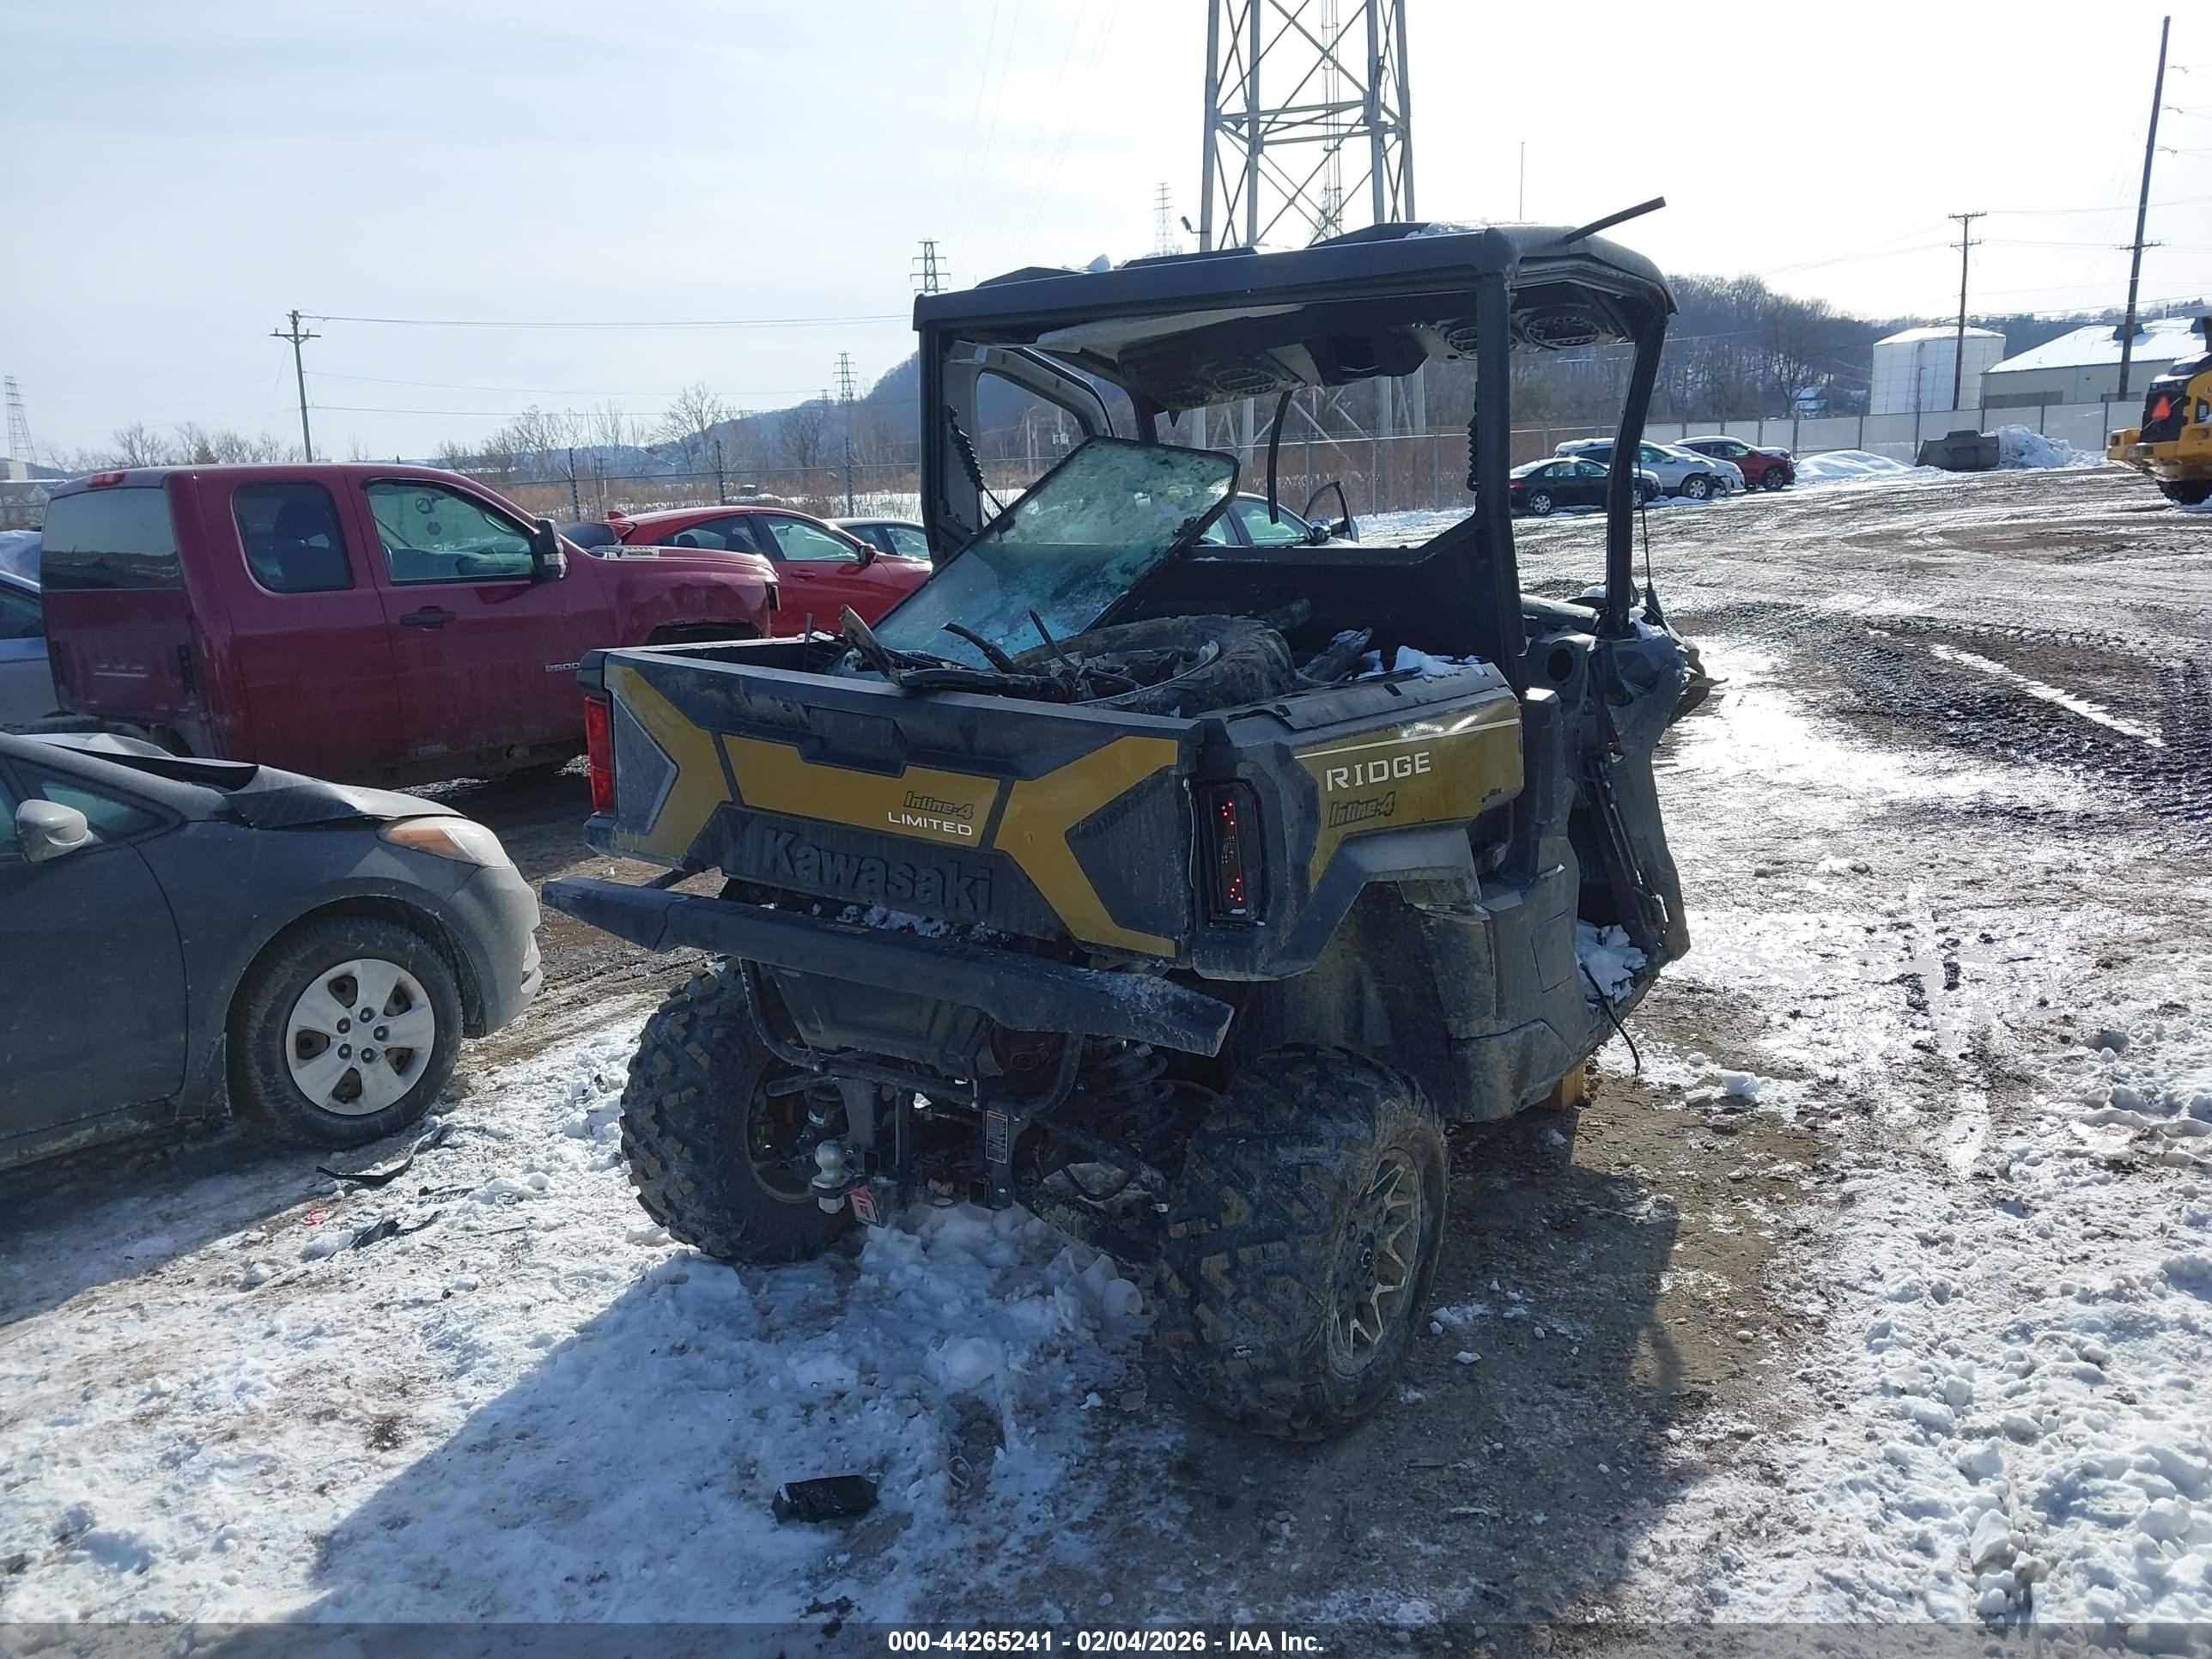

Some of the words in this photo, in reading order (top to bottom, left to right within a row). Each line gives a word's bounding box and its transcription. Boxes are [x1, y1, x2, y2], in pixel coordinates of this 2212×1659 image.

[1327, 752, 1430, 792] RIDGE
[888, 811, 973, 836] LIMITED
[763, 830, 990, 913] Kawasaki
